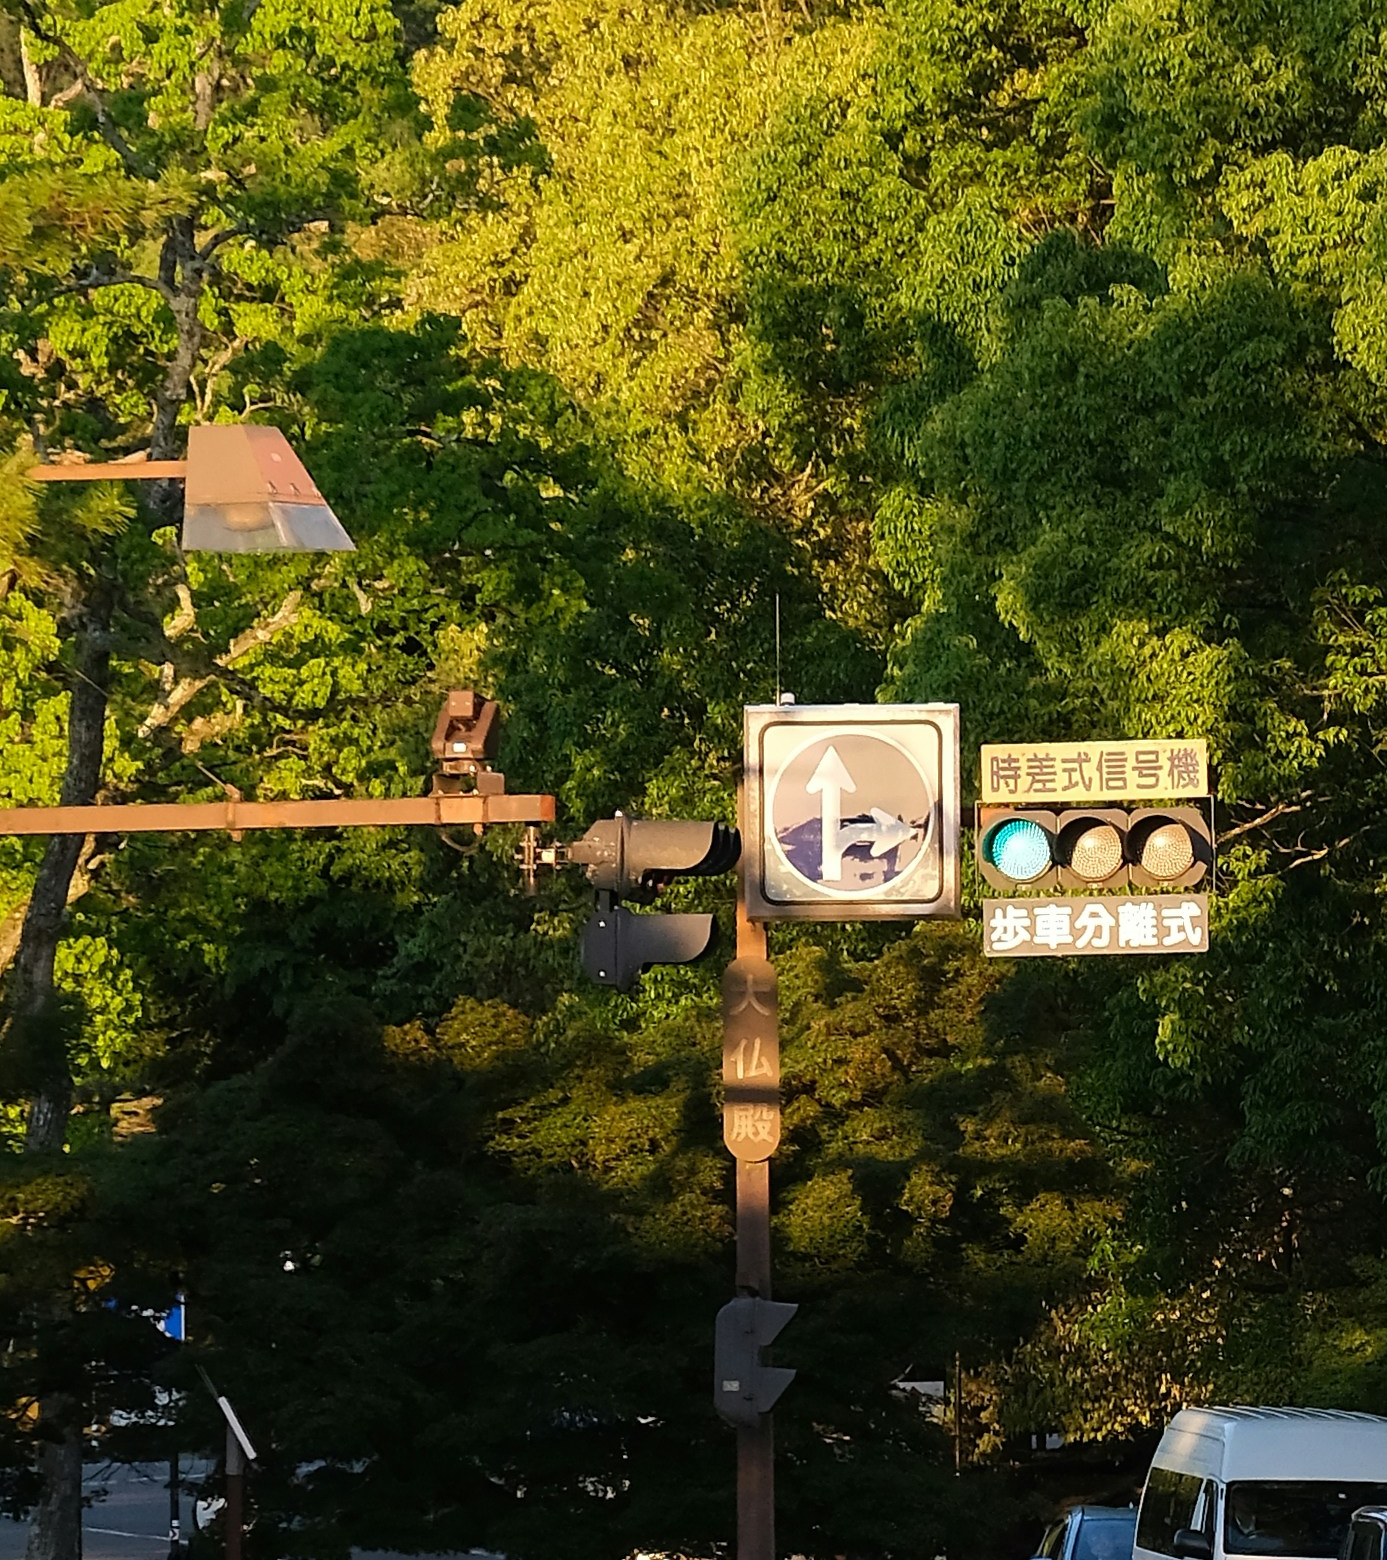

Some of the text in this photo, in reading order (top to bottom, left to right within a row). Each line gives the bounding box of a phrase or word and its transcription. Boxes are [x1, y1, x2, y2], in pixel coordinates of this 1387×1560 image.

[989, 748, 1200, 795] 時差式信号機
[989, 902, 1203, 950] 歩車分離式
[729, 973, 774, 1144] 大仏殿
